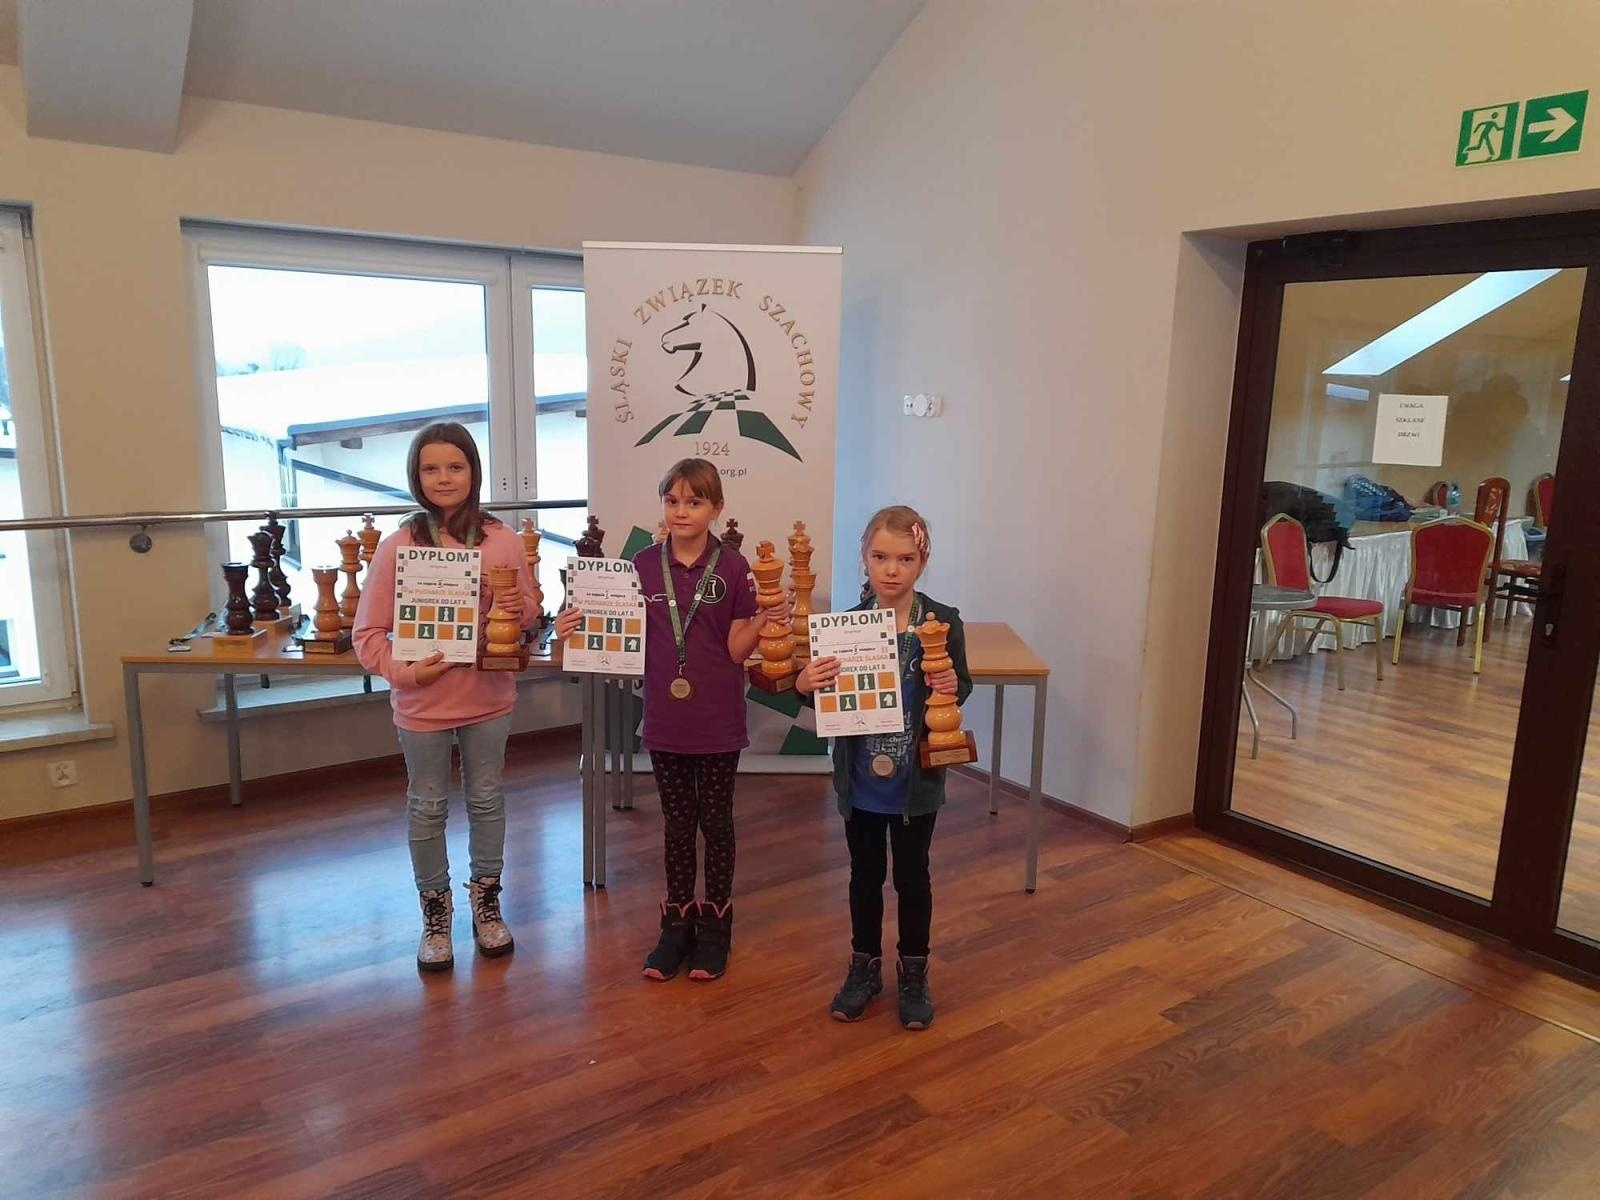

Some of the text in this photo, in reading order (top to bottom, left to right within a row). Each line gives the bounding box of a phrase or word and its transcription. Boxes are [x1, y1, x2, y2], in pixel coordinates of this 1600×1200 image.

[633, 278, 743, 325] ZWIĄZEK
[759, 295, 816, 429] SZACHOWY
[695, 441, 730, 456] 1924
[720, 467, 747, 478] org.pl
[408, 550, 469, 562] DYPLOM
[577, 560, 634, 574] DYPLOM
[821, 612, 883, 628] DYPLOM
